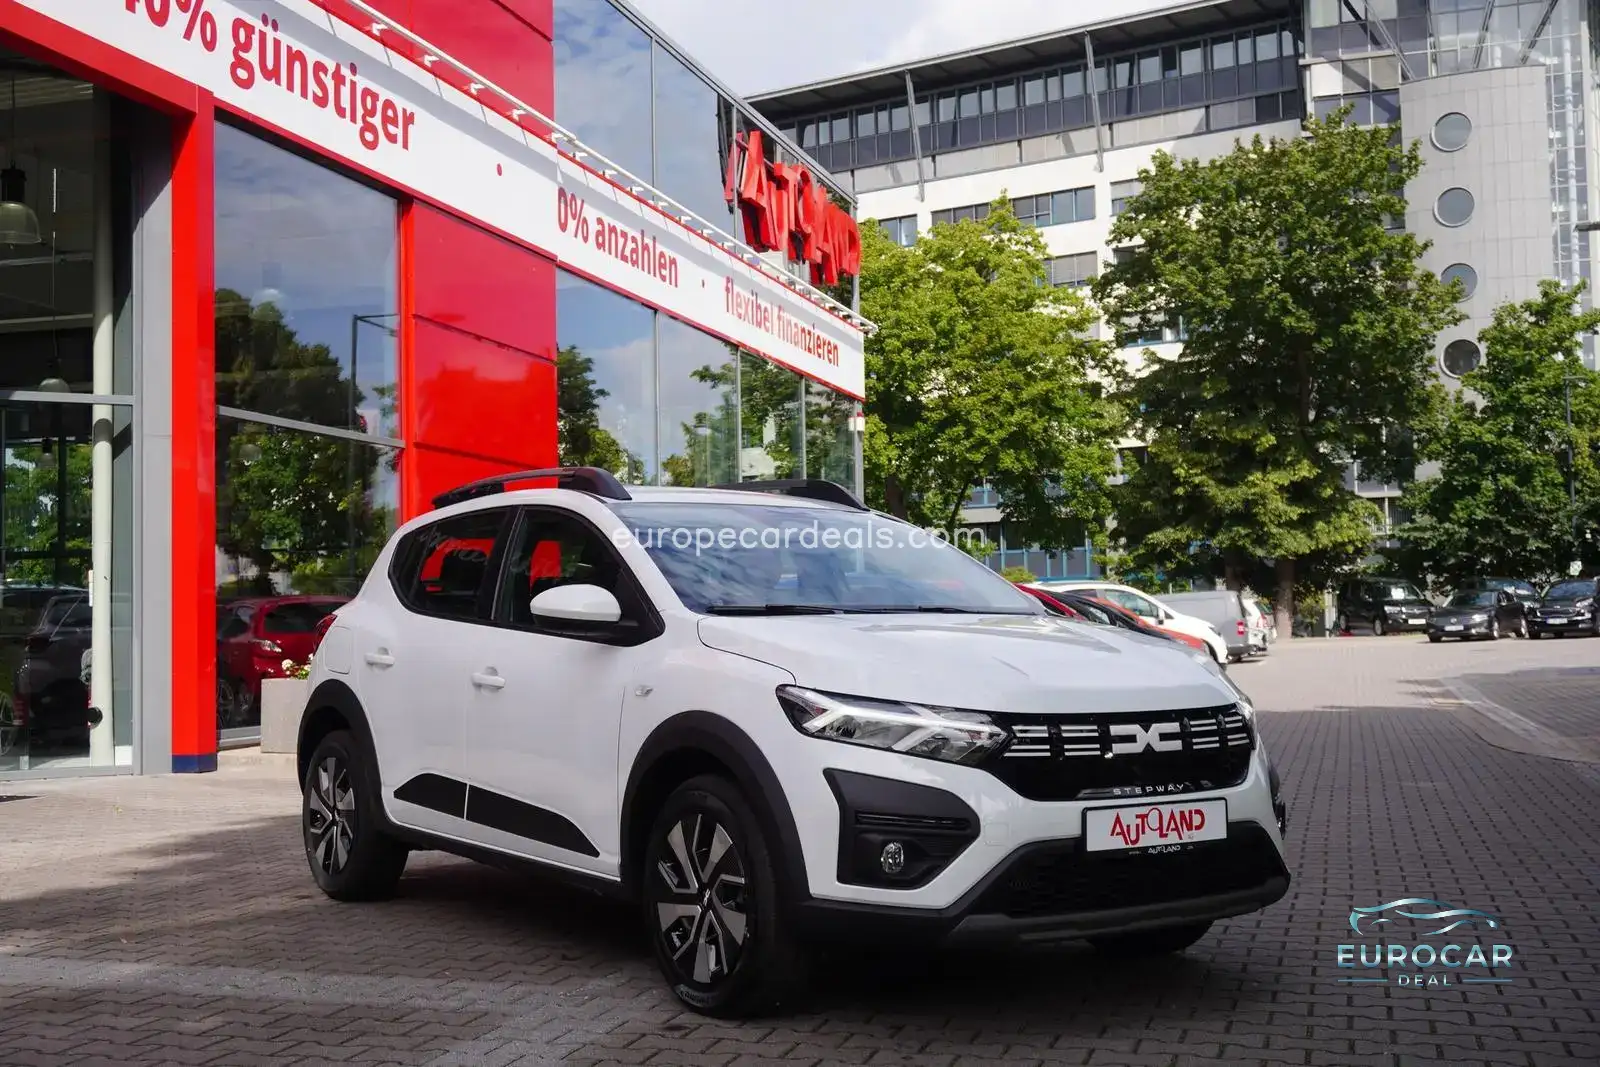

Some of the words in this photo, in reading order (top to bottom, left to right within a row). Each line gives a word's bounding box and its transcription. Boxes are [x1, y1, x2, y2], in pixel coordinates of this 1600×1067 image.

[230, 12, 415, 151] günstiger
[557, 186, 589, 244] 0%
[595, 217, 678, 288] anzahlen
[724, 276, 774, 336] flexibel
[777, 304, 839, 367] finanzieren
[1110, 807, 1206, 846] AUTOLAND
[1113, 783, 1184, 796] STEPWAY
